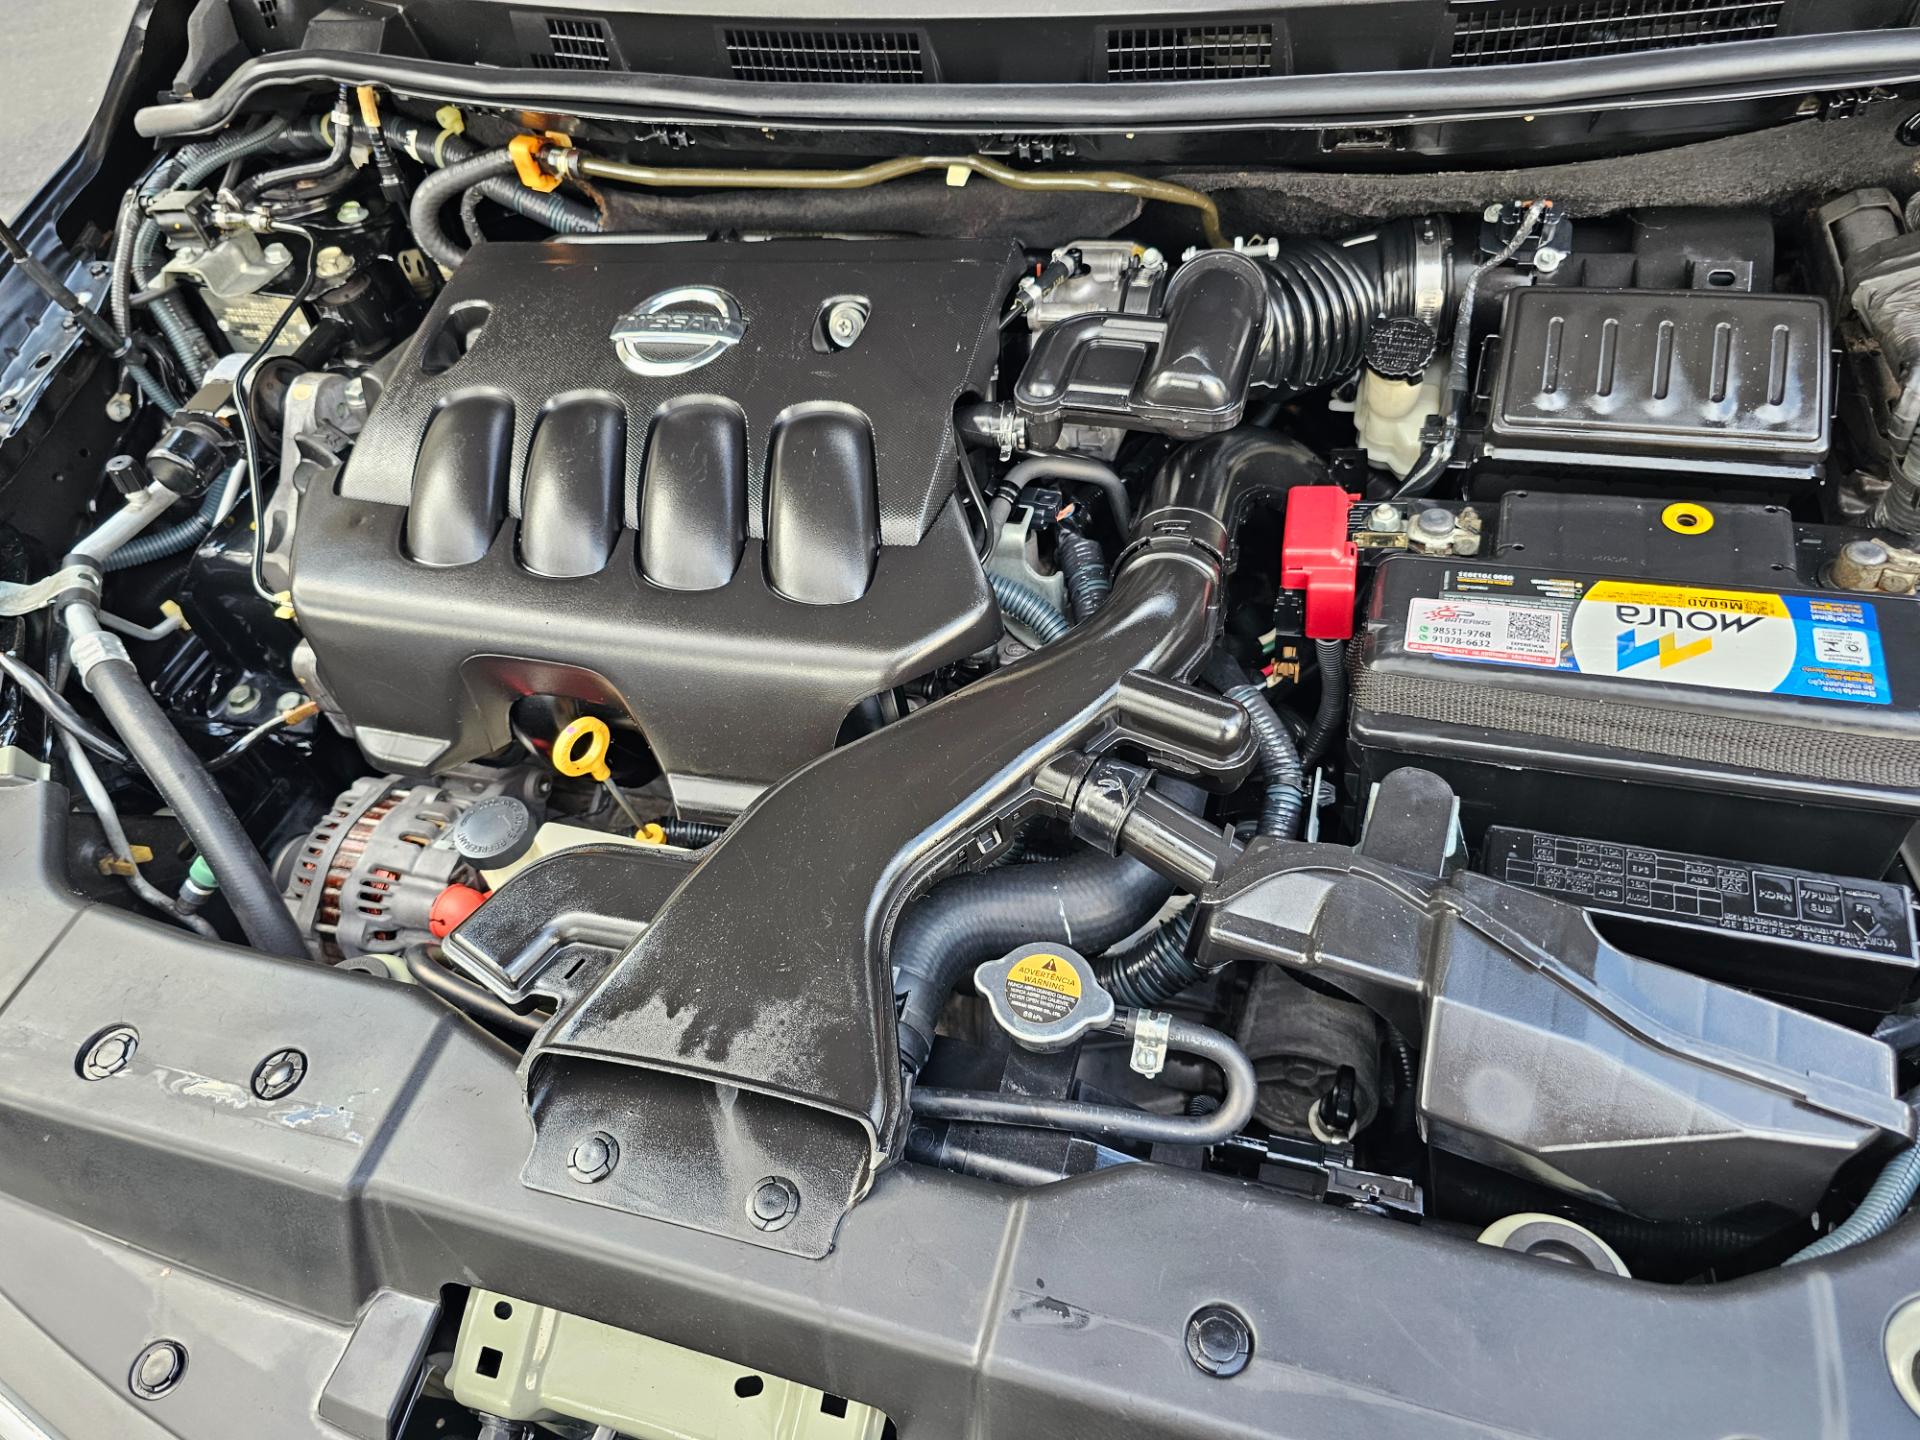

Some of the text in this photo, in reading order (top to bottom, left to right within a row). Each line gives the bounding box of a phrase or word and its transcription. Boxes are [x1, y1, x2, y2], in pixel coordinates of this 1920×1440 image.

[626, 314, 732, 332] NISSAN
[1759, 890, 1793, 903] HORN
[1800, 889, 1840, 903] F/PUMP
[1809, 903, 1833, 914] SUB
[1720, 919, 1737, 930] USE
[1743, 923, 1794, 938] SPECIFIED
[1803, 932, 1836, 945] FUSES
[1024, 976, 1065, 991] WARNING
